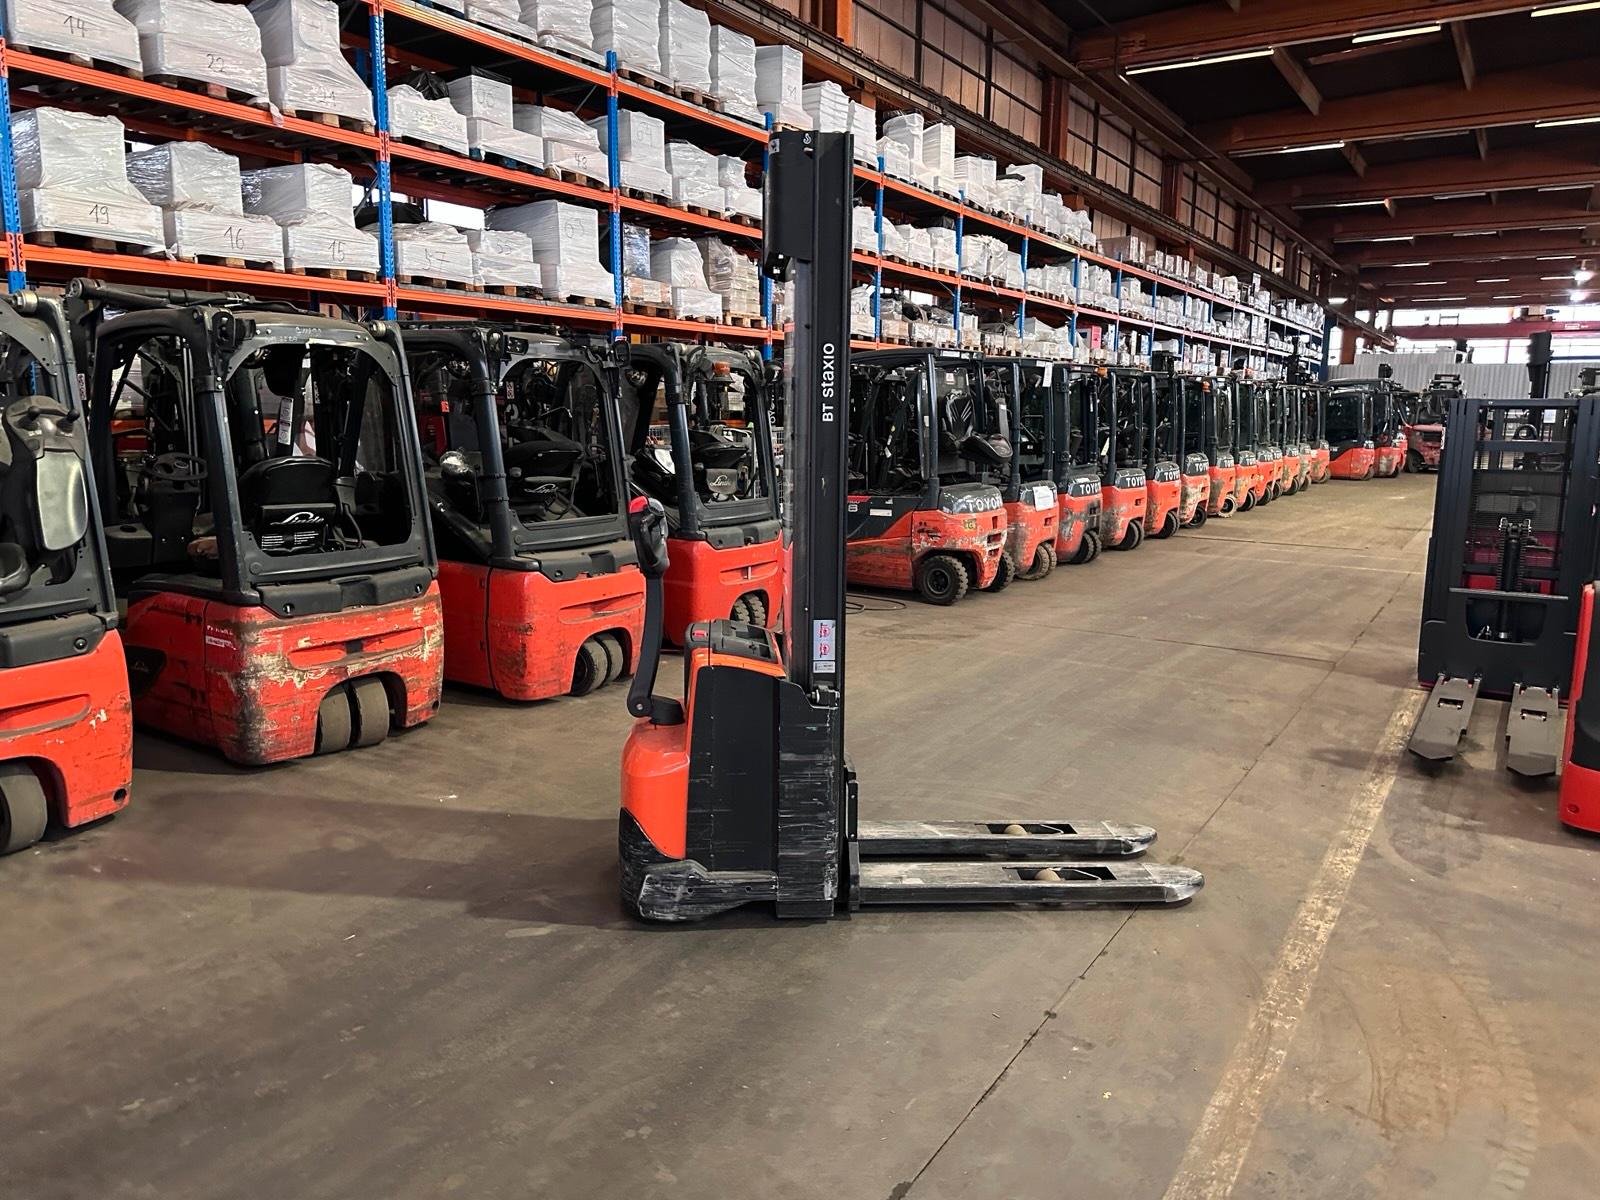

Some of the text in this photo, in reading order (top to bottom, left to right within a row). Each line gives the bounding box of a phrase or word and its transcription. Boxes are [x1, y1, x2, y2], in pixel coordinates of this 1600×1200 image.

[64, 15, 88, 38] 14
[89, 204, 109, 225] 19
[224, 226, 245, 250] 16
[328, 240, 346, 262] 15
[822, 403, 834, 422] BT
